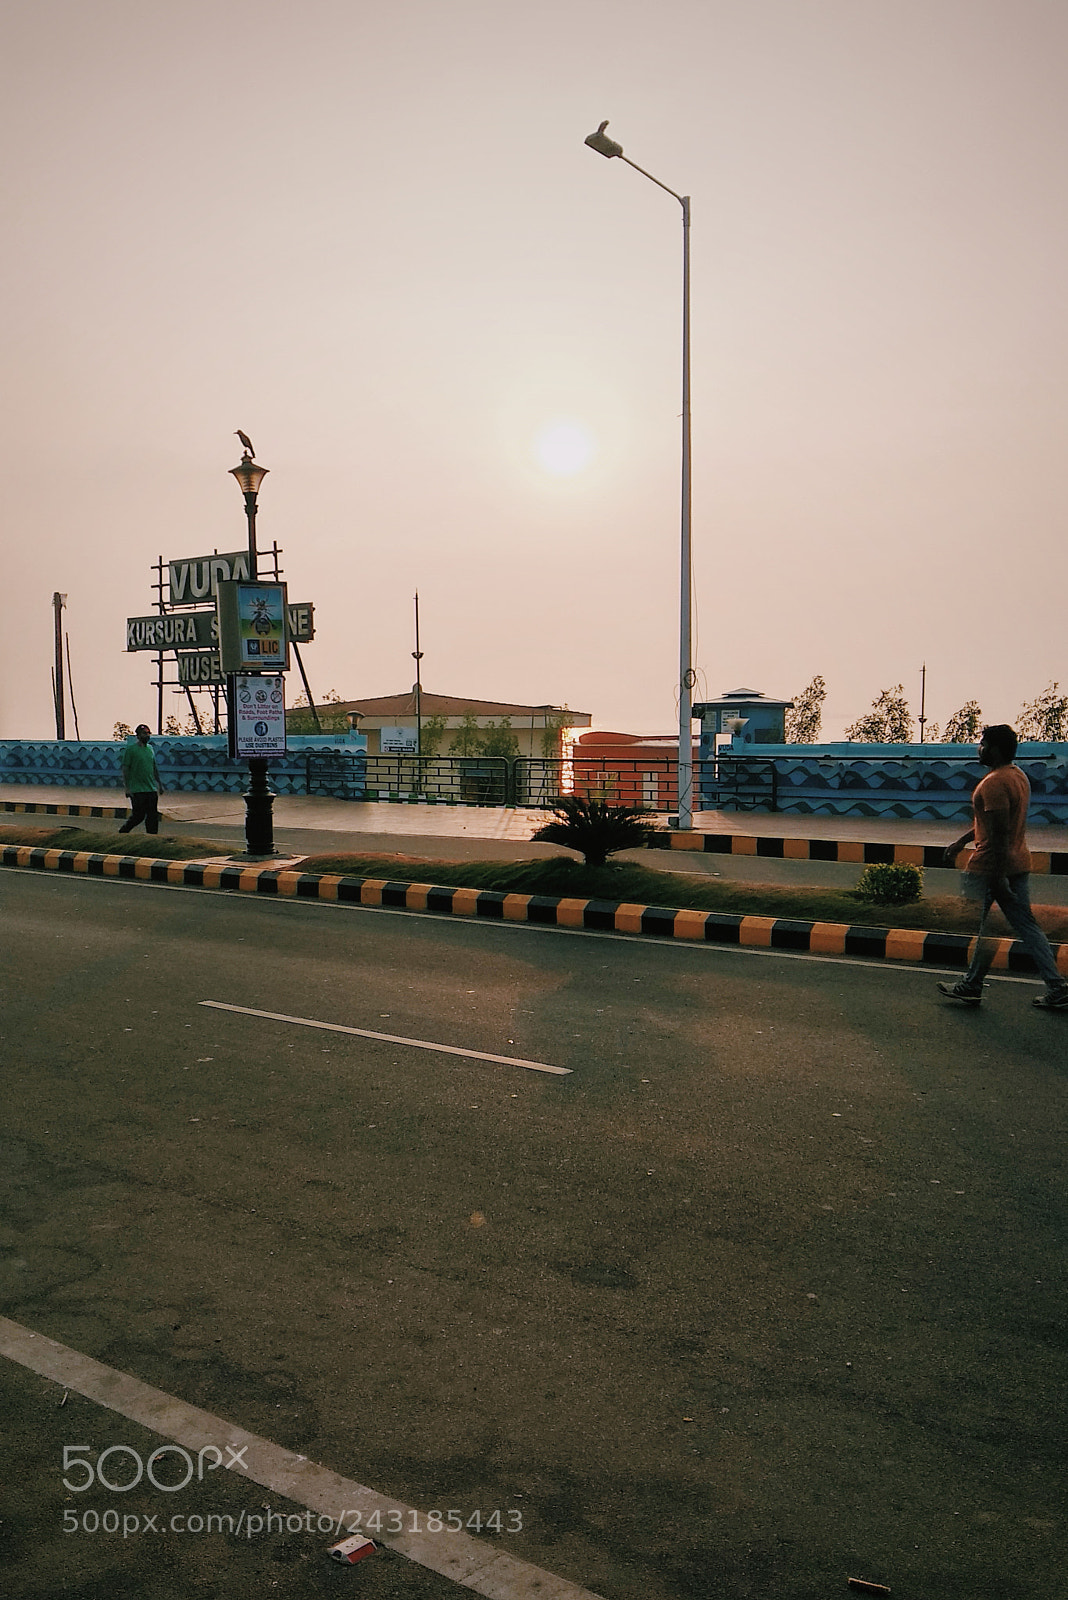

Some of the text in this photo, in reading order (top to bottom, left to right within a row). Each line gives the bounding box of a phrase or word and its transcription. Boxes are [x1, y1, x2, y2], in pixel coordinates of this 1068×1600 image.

[127, 617, 197, 646] KURSURA
[261, 640, 279, 654] LIC
[178, 655, 227, 681] MUSE
